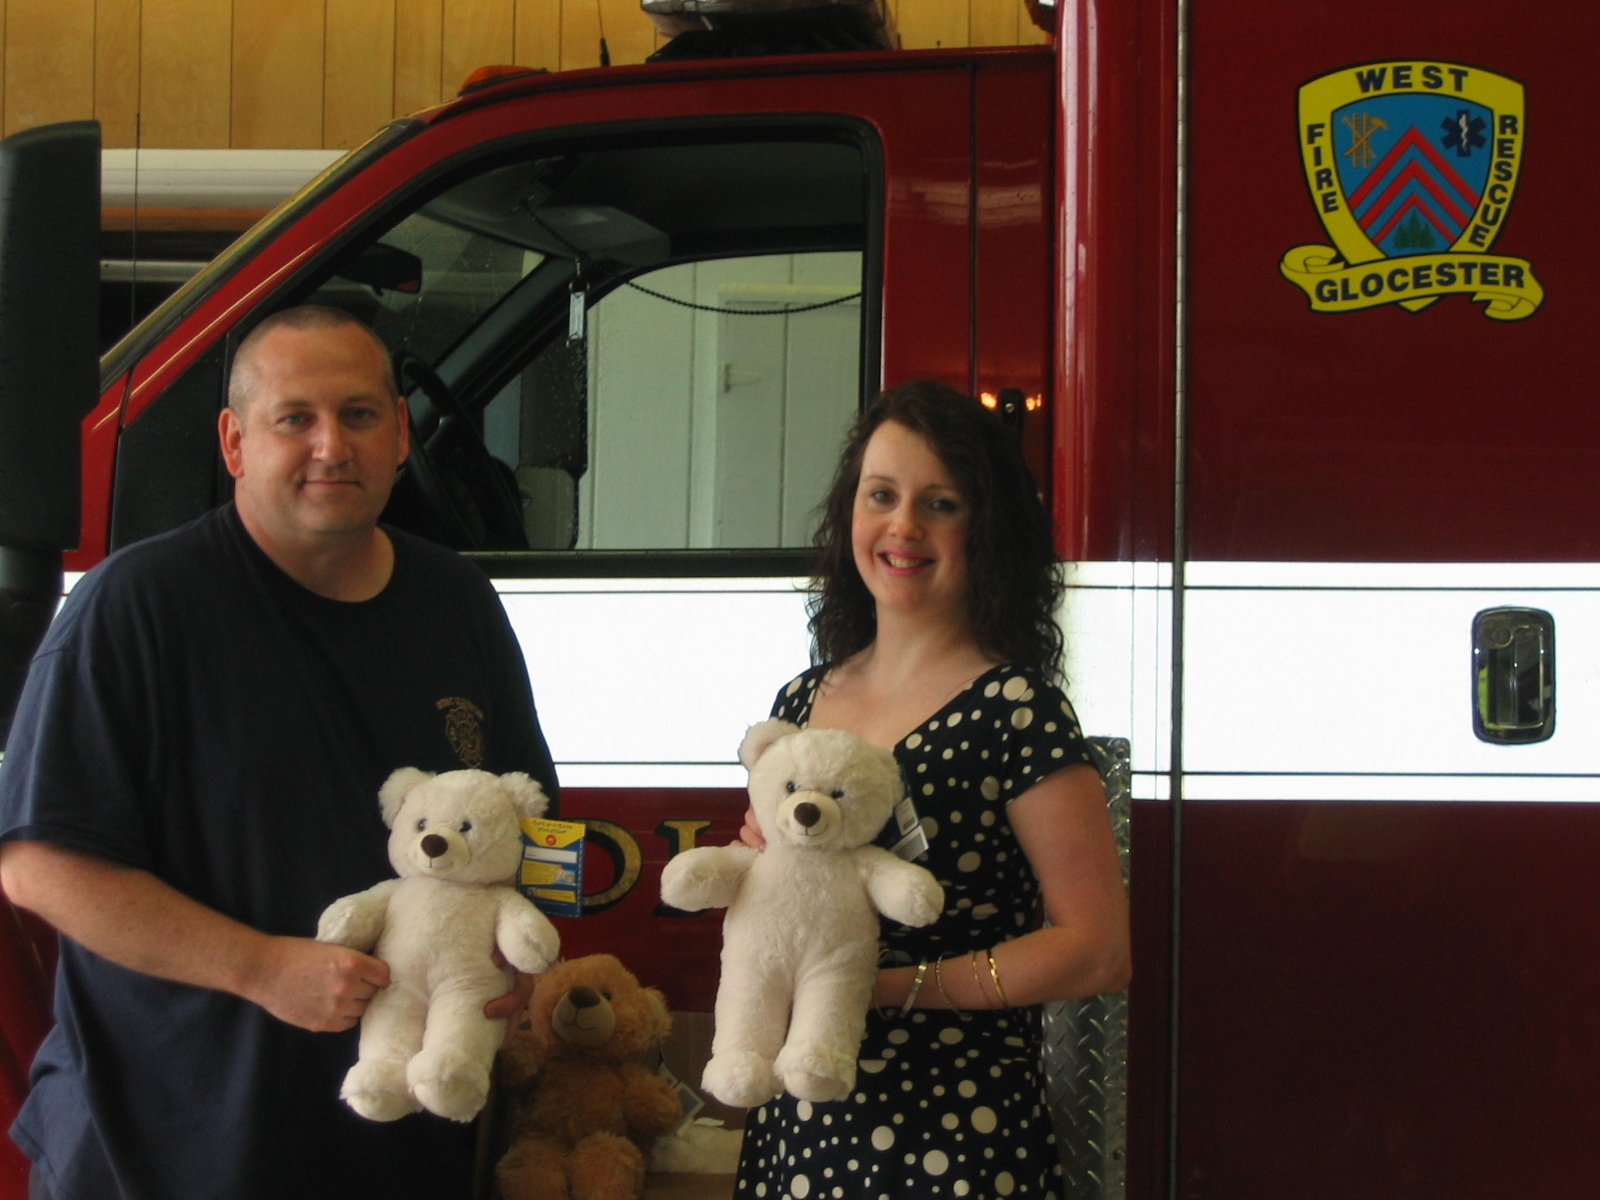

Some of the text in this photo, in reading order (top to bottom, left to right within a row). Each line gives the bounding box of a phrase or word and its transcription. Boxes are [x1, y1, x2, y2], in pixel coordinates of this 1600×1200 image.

[1356, 65, 1468, 93] WEST
[1306, 122, 1339, 214] FIRE
[1467, 114, 1518, 248] RESCUE
[1315, 261, 1525, 302] GLOCESTER
